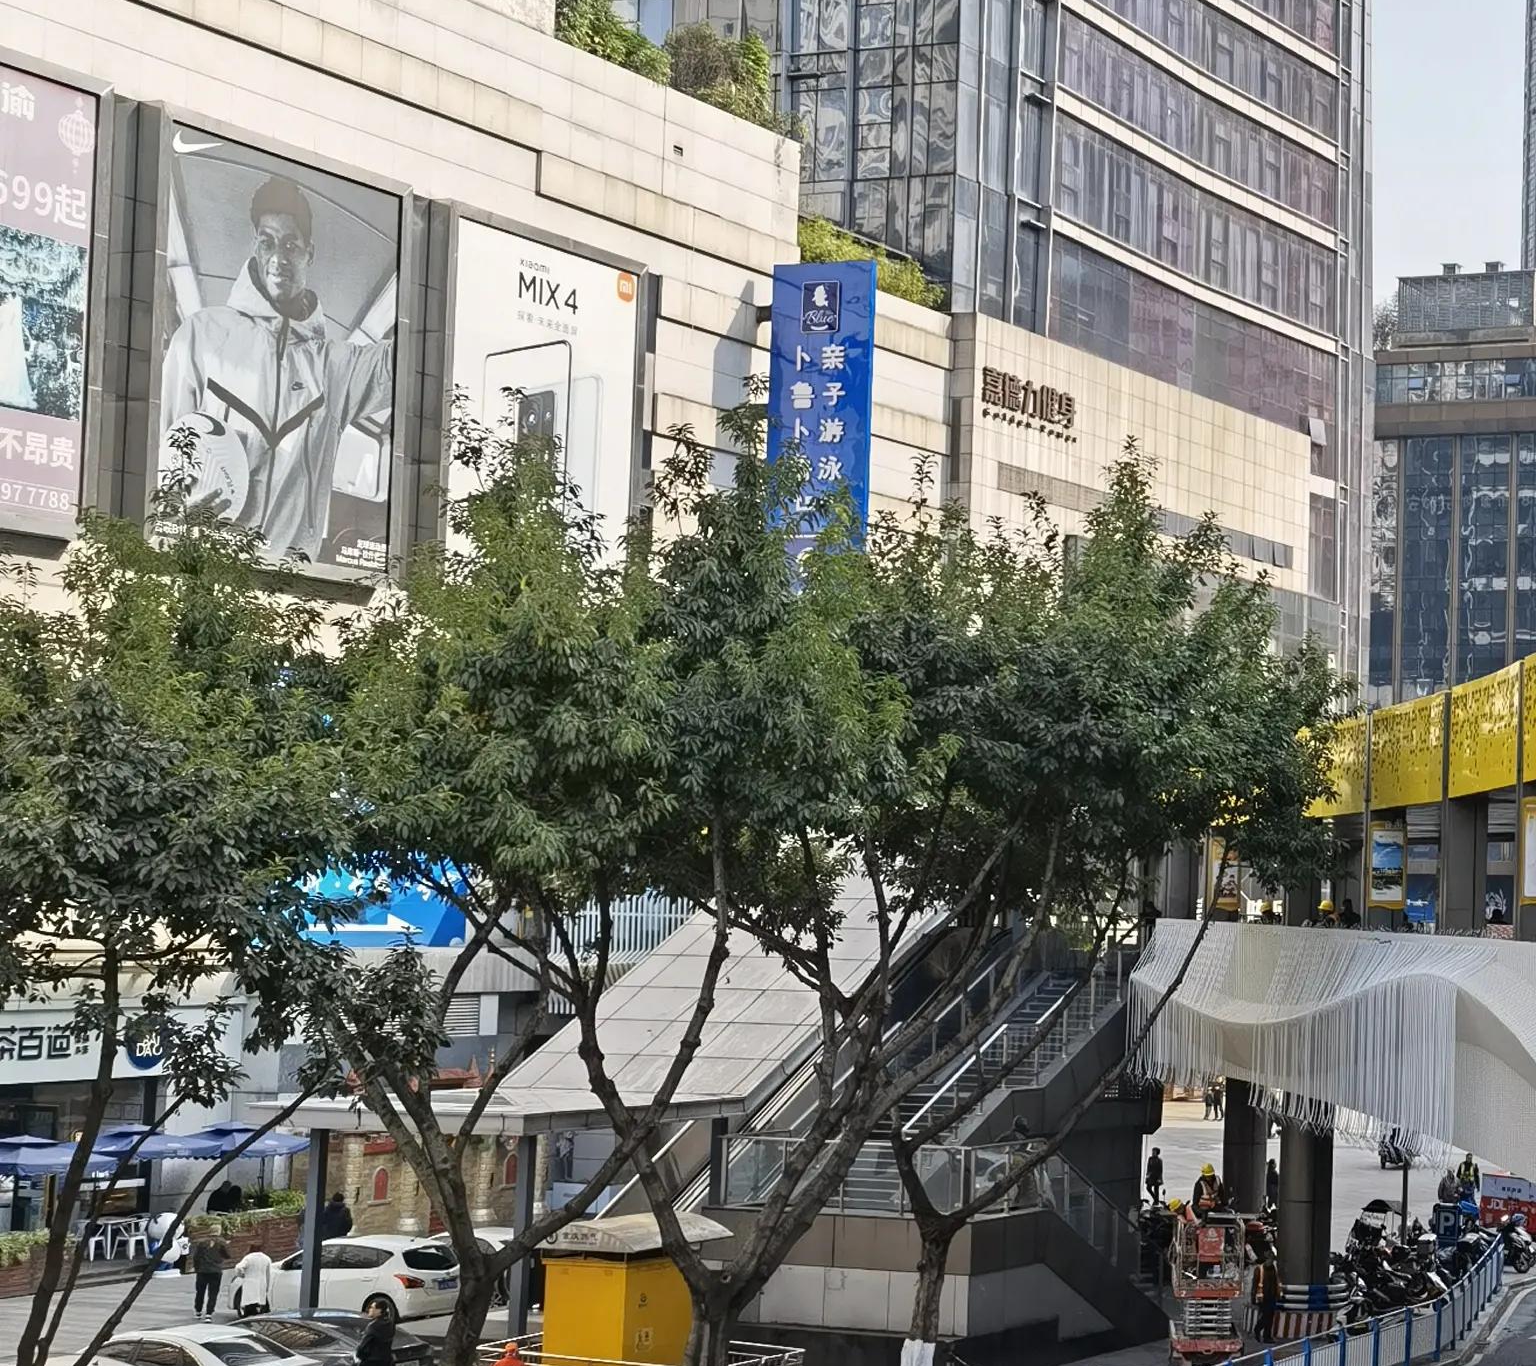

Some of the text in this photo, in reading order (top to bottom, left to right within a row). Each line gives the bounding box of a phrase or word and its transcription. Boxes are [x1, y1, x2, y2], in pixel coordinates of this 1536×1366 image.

[518, 271, 579, 315] MIX 4
[817, 343, 846, 482] 亲子游泳
[0, 427, 76, 471] 不昂贵
[26, 486, 70, 511] 7788
[1440, 1210, 1455, 1235] P
